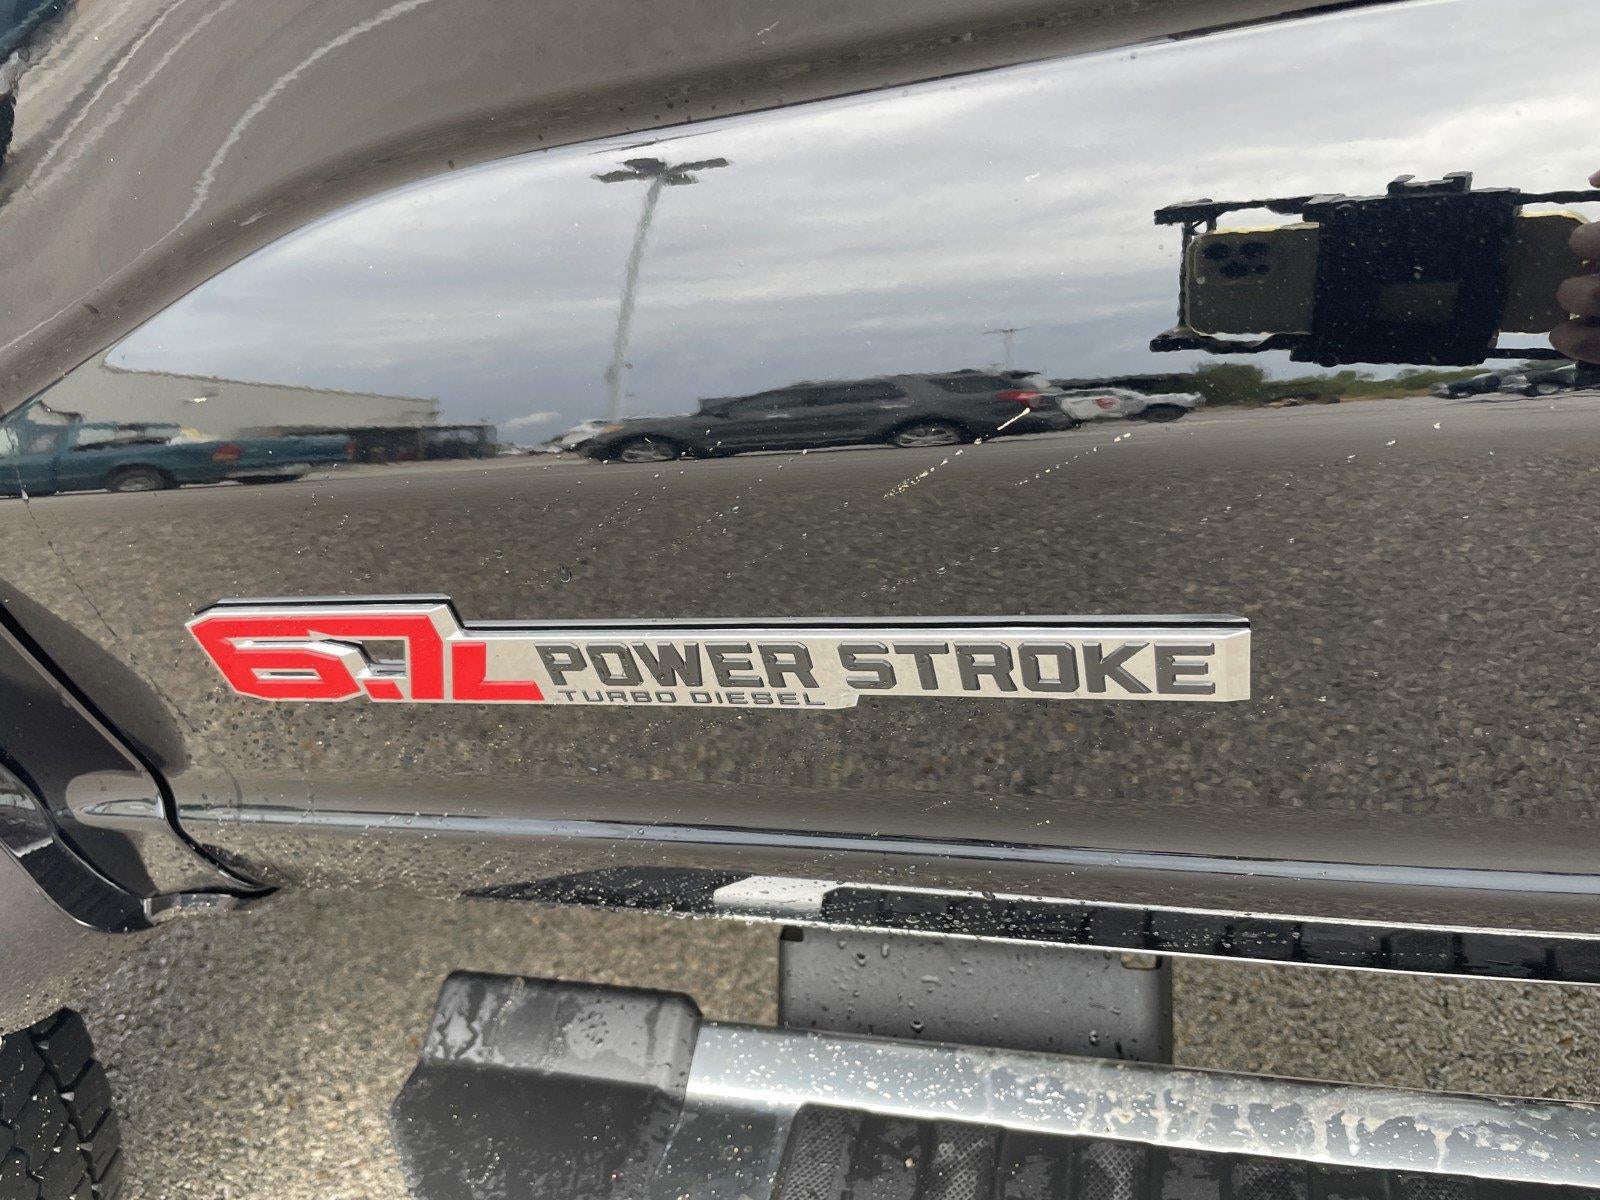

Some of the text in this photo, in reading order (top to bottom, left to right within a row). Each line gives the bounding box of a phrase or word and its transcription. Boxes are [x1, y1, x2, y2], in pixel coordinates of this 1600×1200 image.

[190, 614, 1216, 701] 6.7L POWER STROKE
[557, 689, 826, 706] TURBO DIESEL
